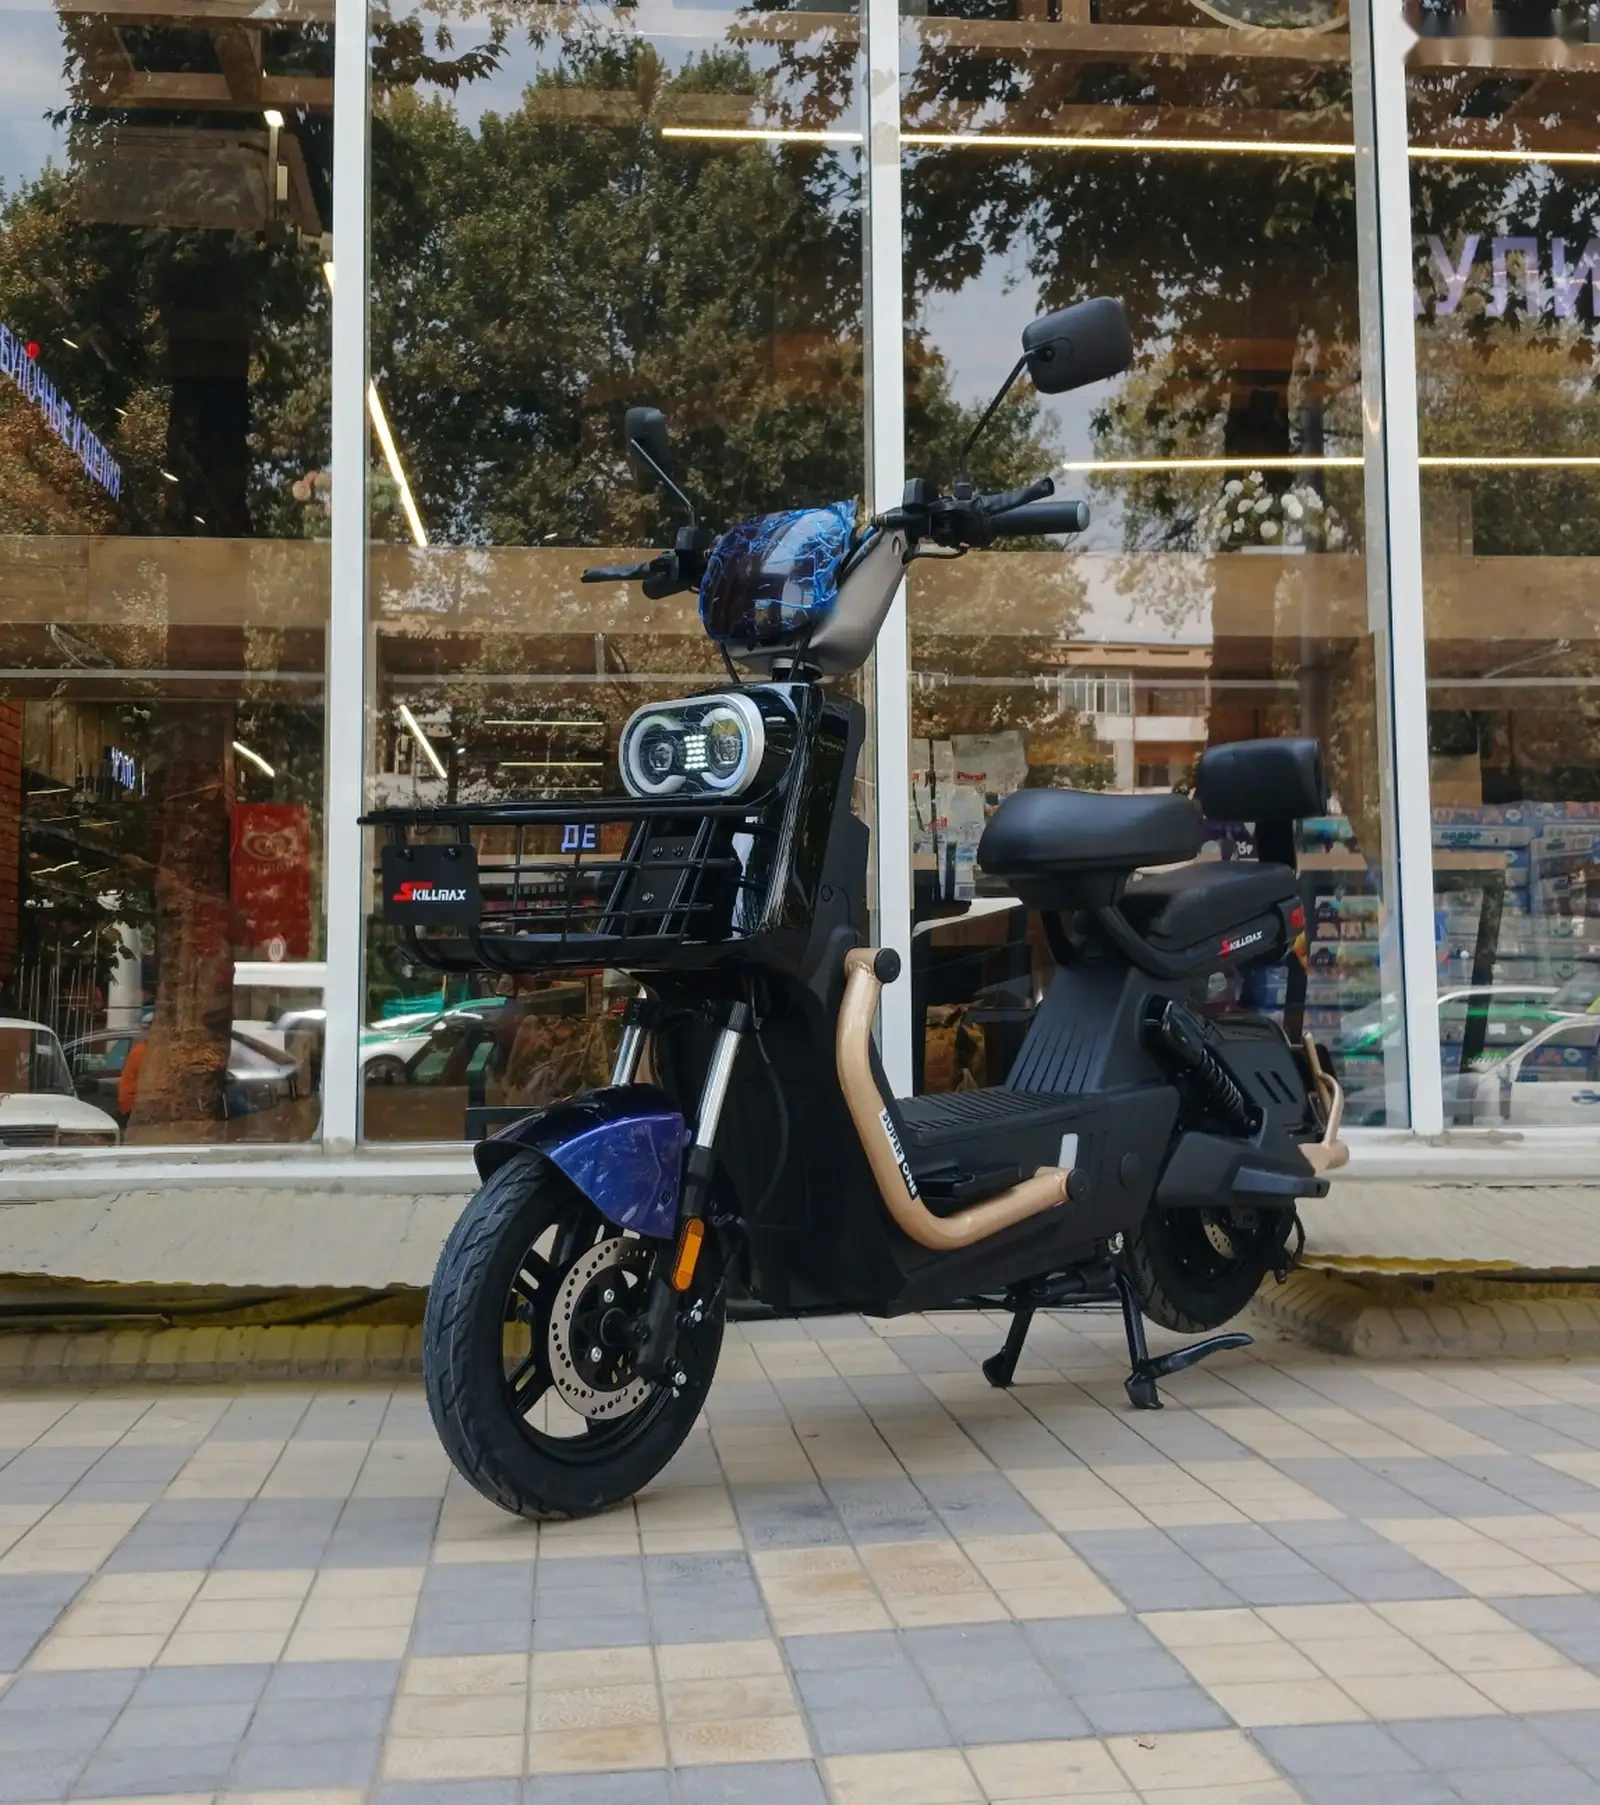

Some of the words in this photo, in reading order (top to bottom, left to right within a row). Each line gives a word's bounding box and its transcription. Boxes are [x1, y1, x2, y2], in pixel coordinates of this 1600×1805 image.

[1413, 234, 1600, 317] УЛИ
[393, 881, 466, 901] SKILLMAX
[881, 1111, 905, 1159] SUPER
[901, 1161, 918, 1196] ONE
